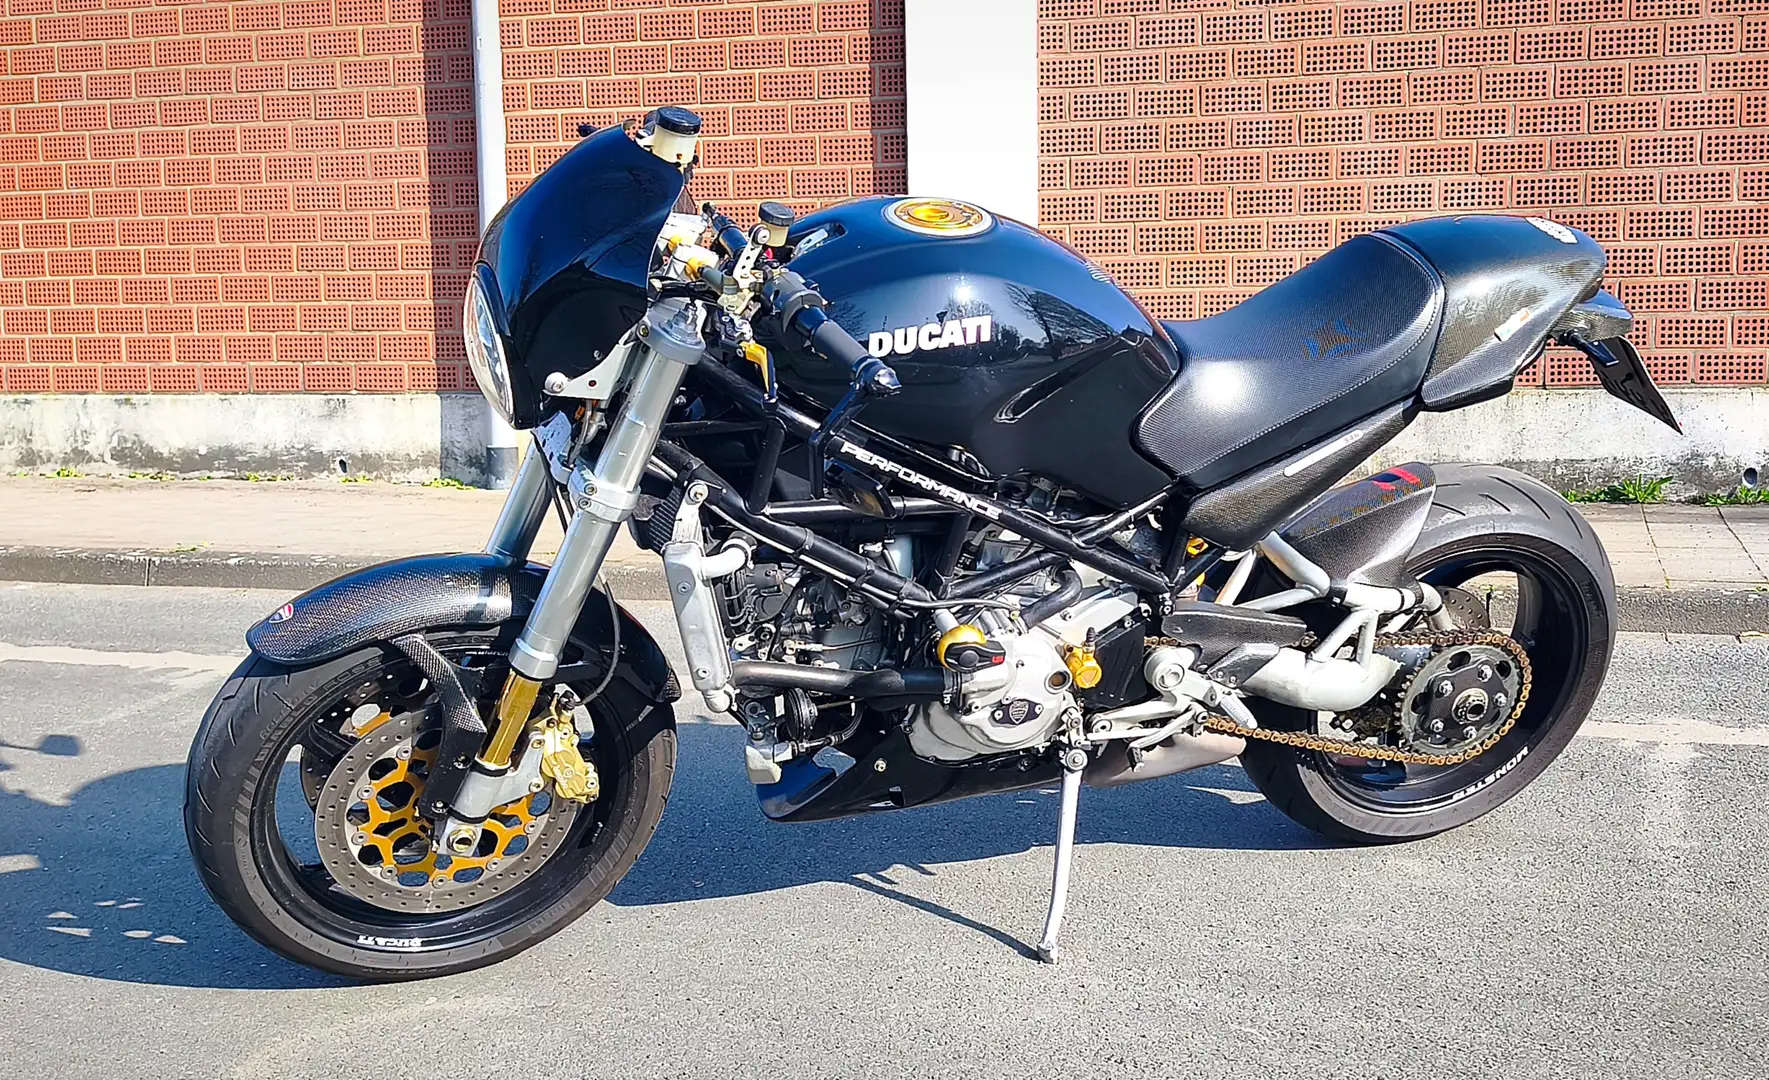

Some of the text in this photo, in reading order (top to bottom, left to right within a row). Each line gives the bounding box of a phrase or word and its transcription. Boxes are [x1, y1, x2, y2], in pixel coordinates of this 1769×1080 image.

[868, 314, 992, 358] DUCATI
[840, 441, 1003, 520] PERFORMANCE
[323, 656, 382, 691] ROSS
